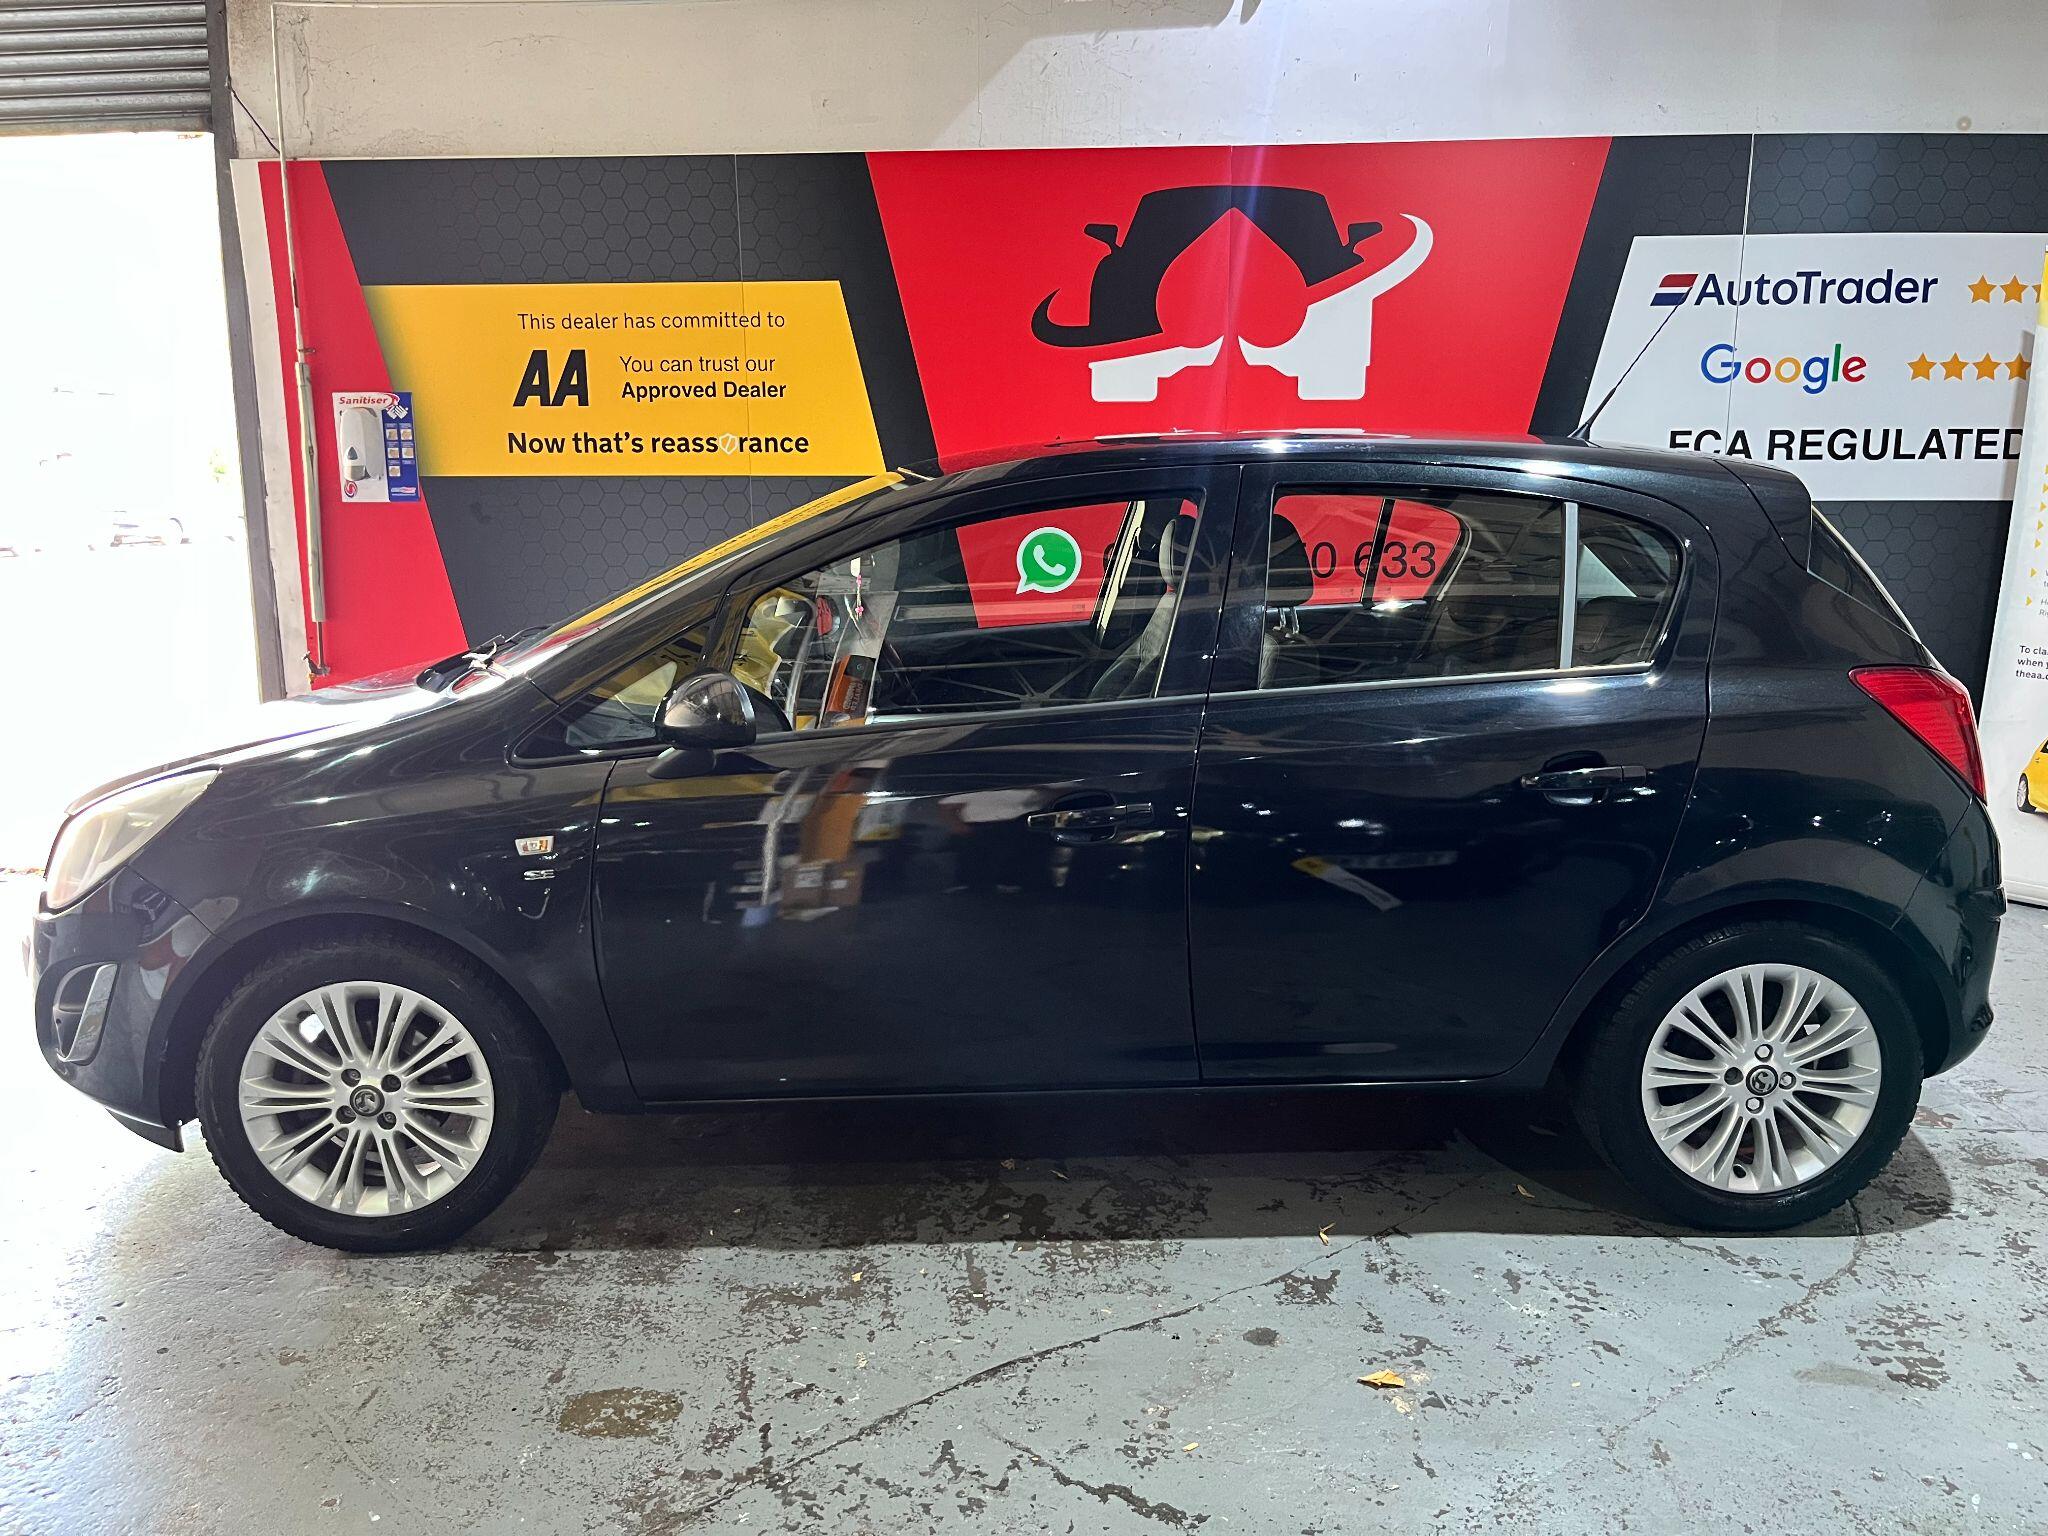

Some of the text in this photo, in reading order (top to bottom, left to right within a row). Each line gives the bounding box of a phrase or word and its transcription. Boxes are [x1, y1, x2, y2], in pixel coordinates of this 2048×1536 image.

[1694, 269, 1938, 306] AutoTrader
[517, 311, 785, 330] This dealer has committed to
[619, 356, 776, 372] You can trust our
[1700, 343, 1867, 394] Google
[512, 349, 589, 407] AA
[338, 396, 388, 405] Sanitiser
[621, 381, 787, 402] Approved Dealer
[507, 431, 809, 455] Now that’s reassrance
[1767, 428, 2022, 461] REGULATED
[2019, 645, 2048, 655] To cla
[2017, 657, 2044, 668] when
